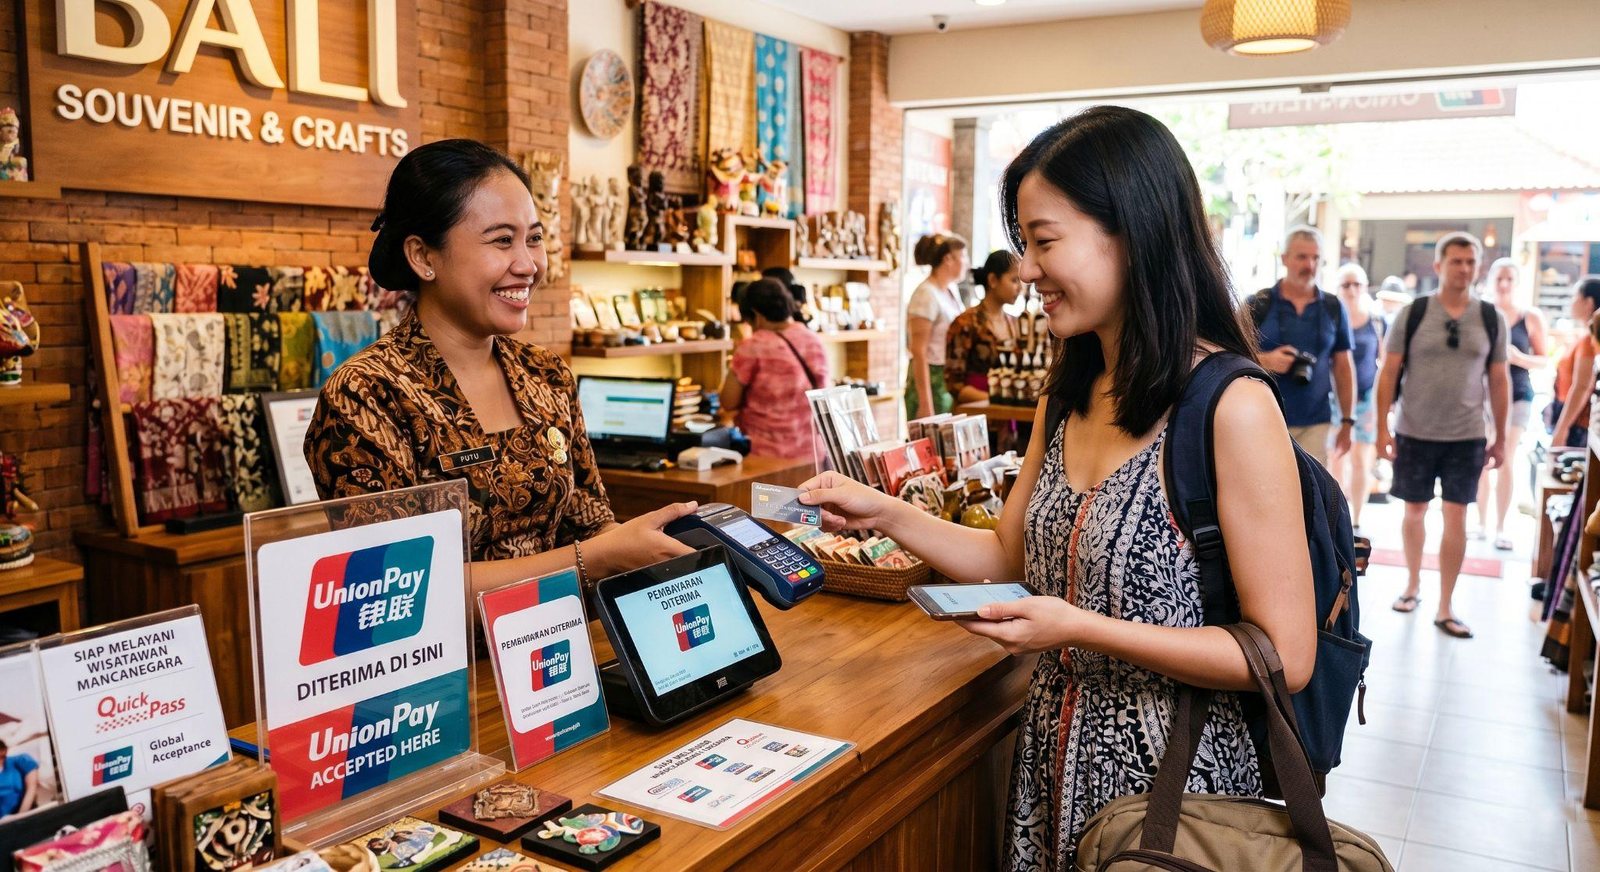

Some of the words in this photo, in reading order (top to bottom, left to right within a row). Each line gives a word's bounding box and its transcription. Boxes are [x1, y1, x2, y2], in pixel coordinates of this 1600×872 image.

[56, 84, 253, 141] SOUVENIR
[260, 111, 285, 144] &
[291, 115, 409, 158] CRAFTS
[460, 453, 479, 463] PUTU
[313, 566, 425, 610] UnionPay
[647, 575, 704, 602] PEMBAYARAN
[660, 589, 702, 610] DITERIMA
[550, 617, 583, 634] DITERIMA
[675, 615, 710, 634] UnionPay
[74, 646, 104, 663] SIAP
[109, 629, 175, 655] MELAYANI
[87, 645, 169, 674] WISATAWAN
[77, 655, 183, 691] MANCANEGARA
[297, 660, 386, 701] DITERIMA
[390, 653, 408, 673] DI
[412, 642, 444, 666] SINI
[532, 652, 569, 671] UnionPay
[97, 691, 149, 718] Quick
[149, 697, 186, 718] Pass
[149, 732, 185, 751] Global
[308, 700, 440, 762] UnionPay
[152, 738, 212, 764] Acceptance
[310, 744, 398, 790] ACCEPTED
[400, 728, 441, 757] HERE
